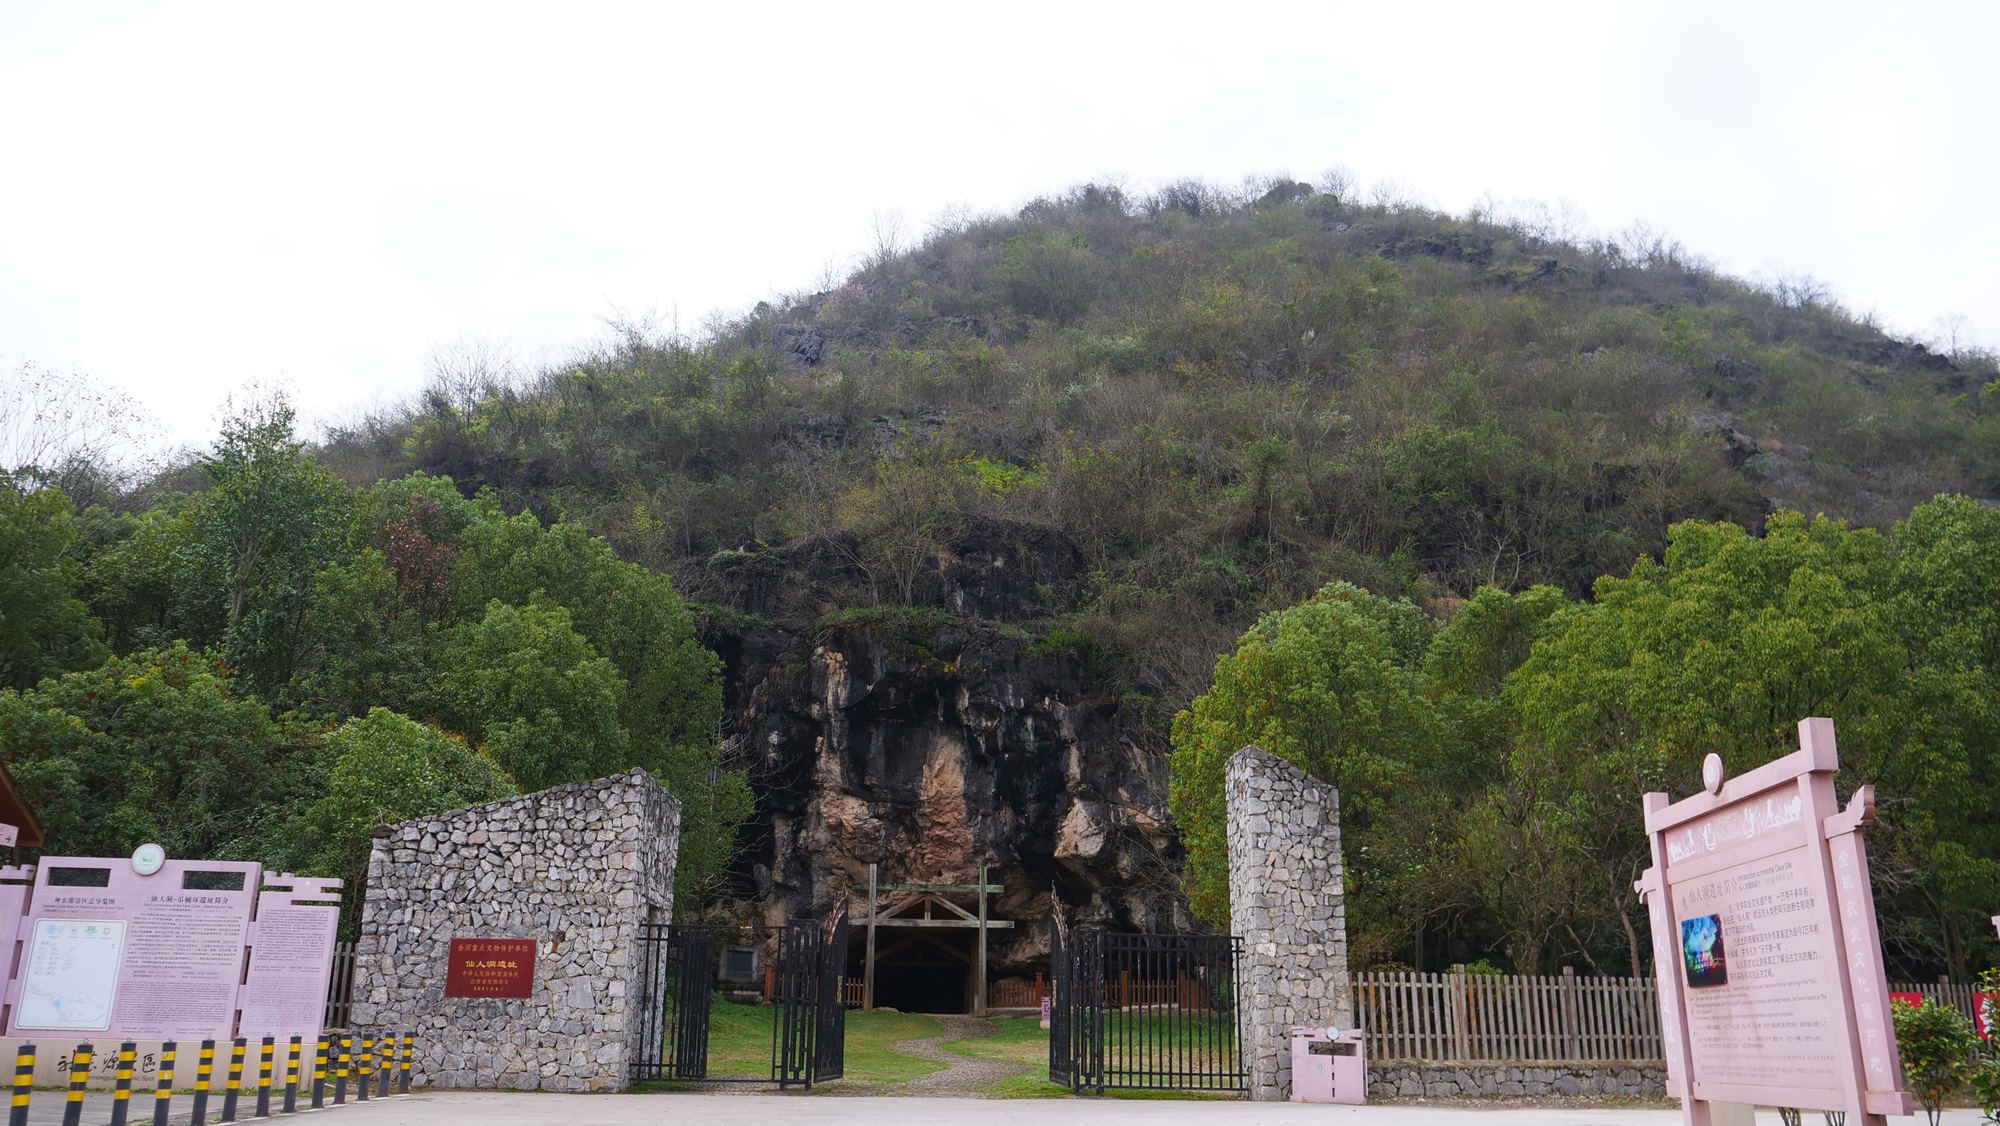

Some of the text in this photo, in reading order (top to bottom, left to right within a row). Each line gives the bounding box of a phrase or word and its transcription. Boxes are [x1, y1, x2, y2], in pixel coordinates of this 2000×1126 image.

[1689, 877, 1738, 905] 仙人洞遗址简介
[457, 944, 529, 952] 全国重点文物保护单位
[465, 960, 518, 969] 仙人洞遗址
[1838, 850, 1883, 1073] 全球农业文化遗产地
